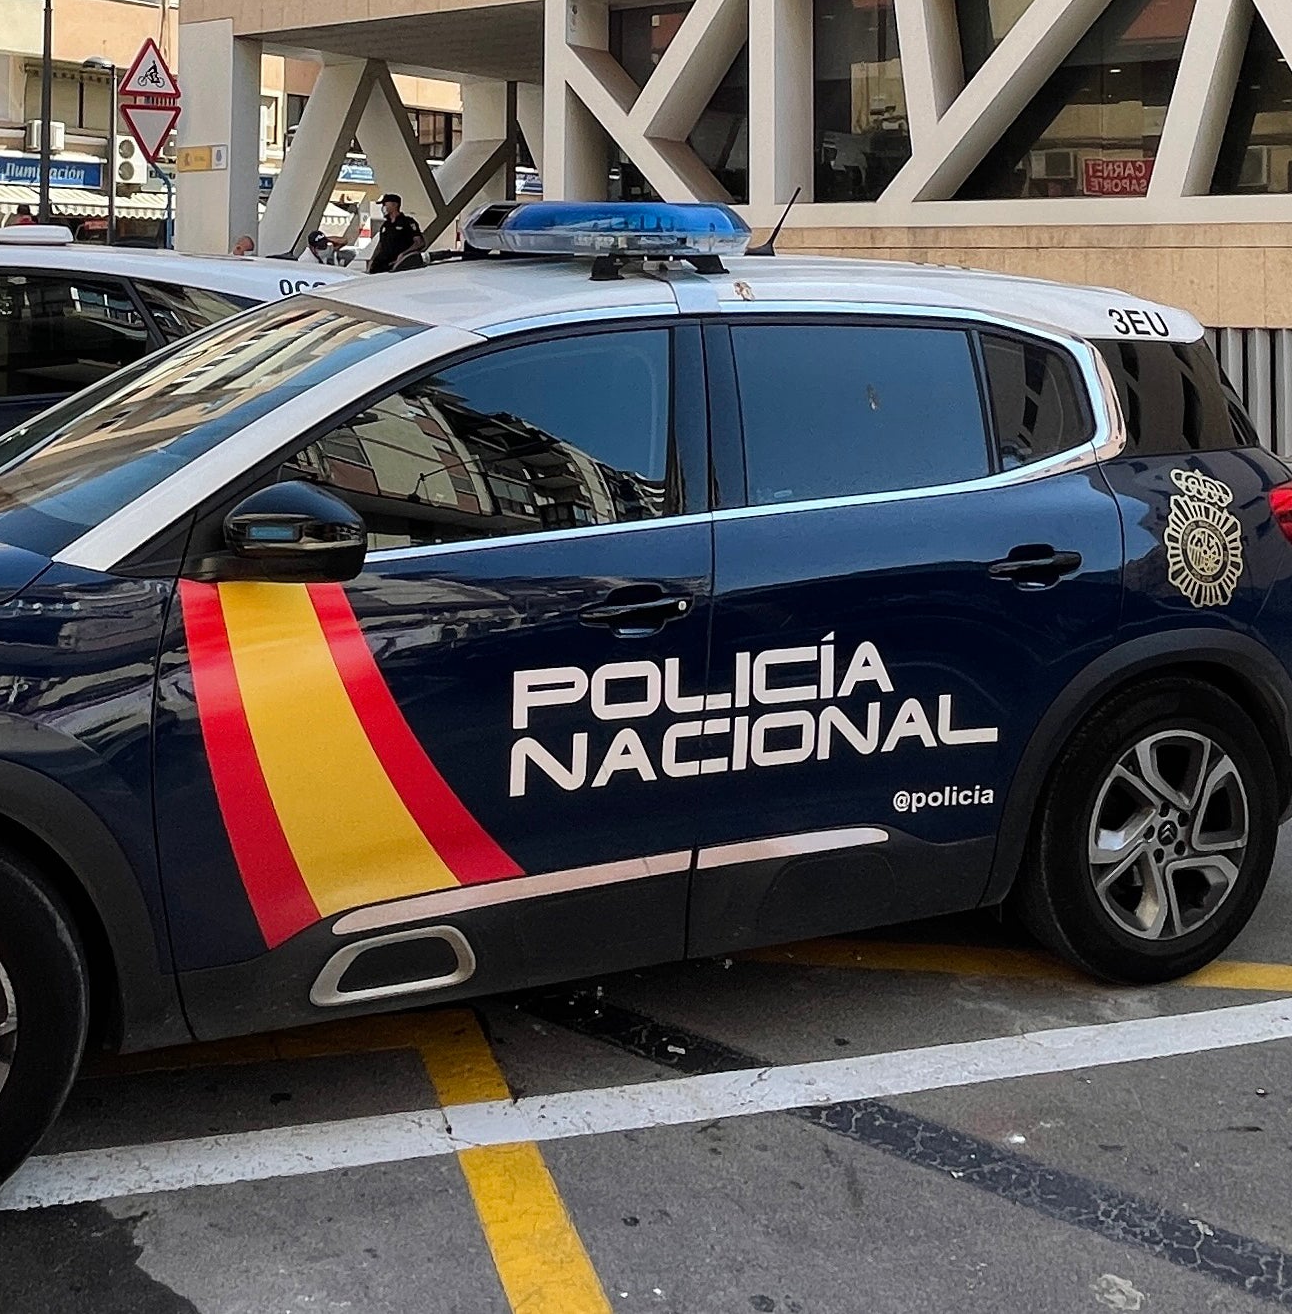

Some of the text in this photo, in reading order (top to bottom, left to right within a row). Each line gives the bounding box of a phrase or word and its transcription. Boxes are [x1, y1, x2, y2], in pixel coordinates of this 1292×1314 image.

[4, 162, 85, 181] Ilumiación
[1108, 309, 1169, 337] 3EU
[513, 632, 894, 729] POLICÍA
[509, 694, 998, 797] NACIONAL
[893, 785, 994, 813] @policia
